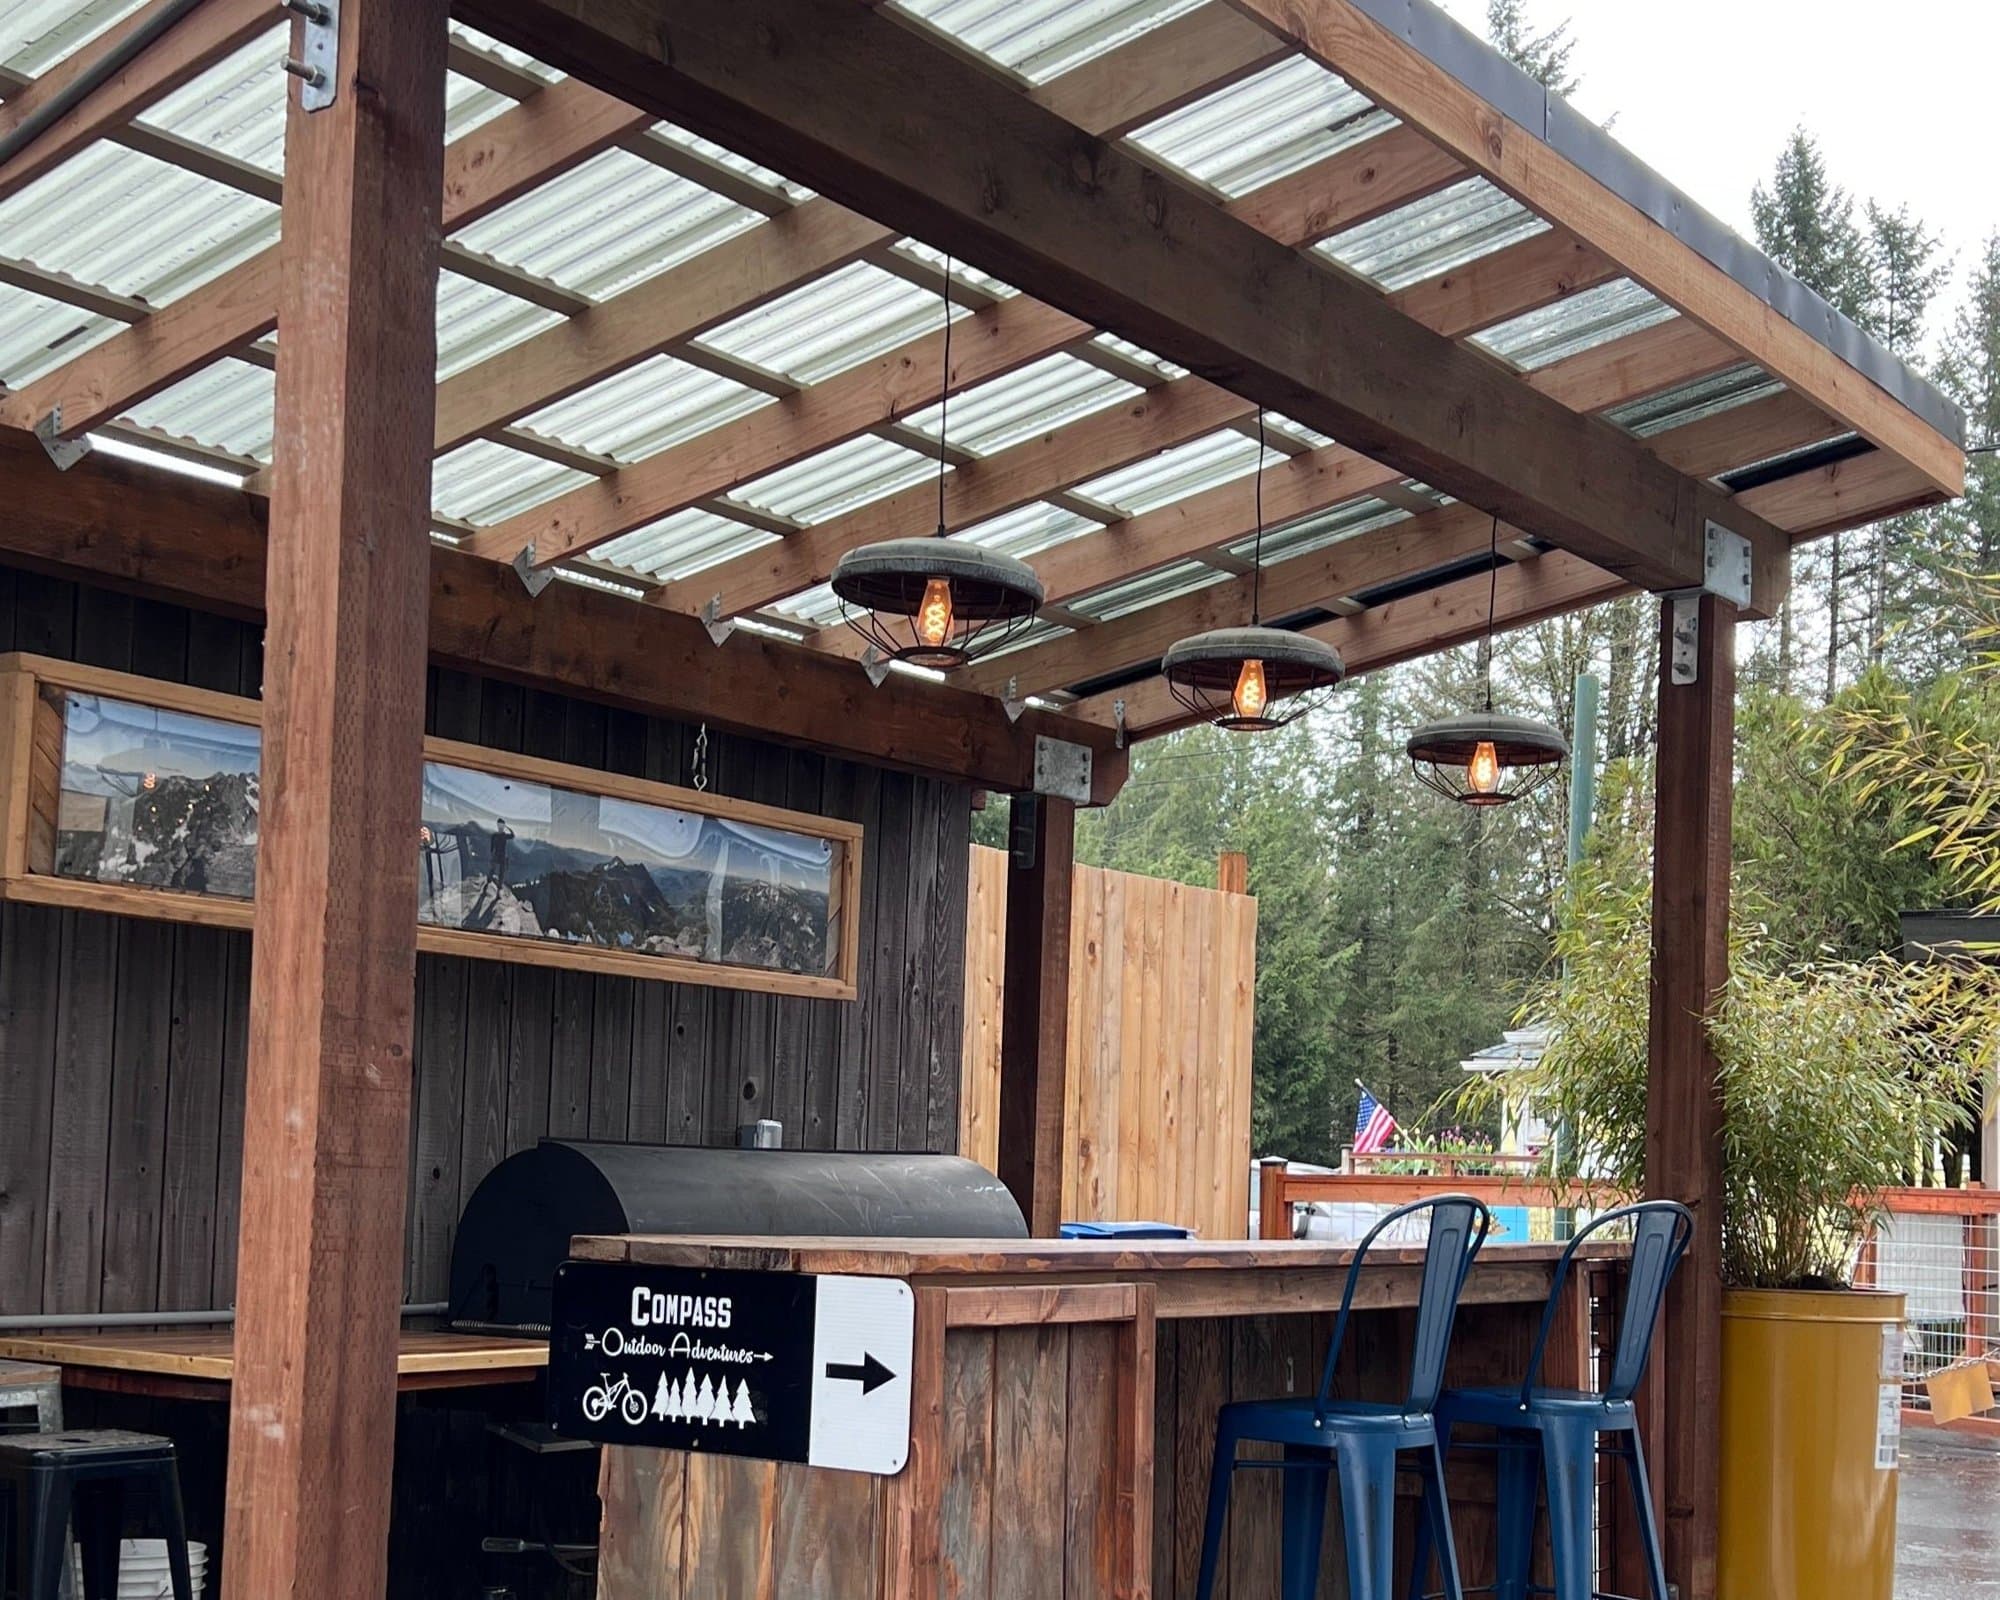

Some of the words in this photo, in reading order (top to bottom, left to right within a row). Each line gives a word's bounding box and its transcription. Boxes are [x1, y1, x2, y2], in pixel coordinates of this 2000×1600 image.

[631, 1286, 732, 1328] COMPASS
[601, 1327, 666, 1357] Outdoor
[668, 1332, 754, 1363] Adventures
